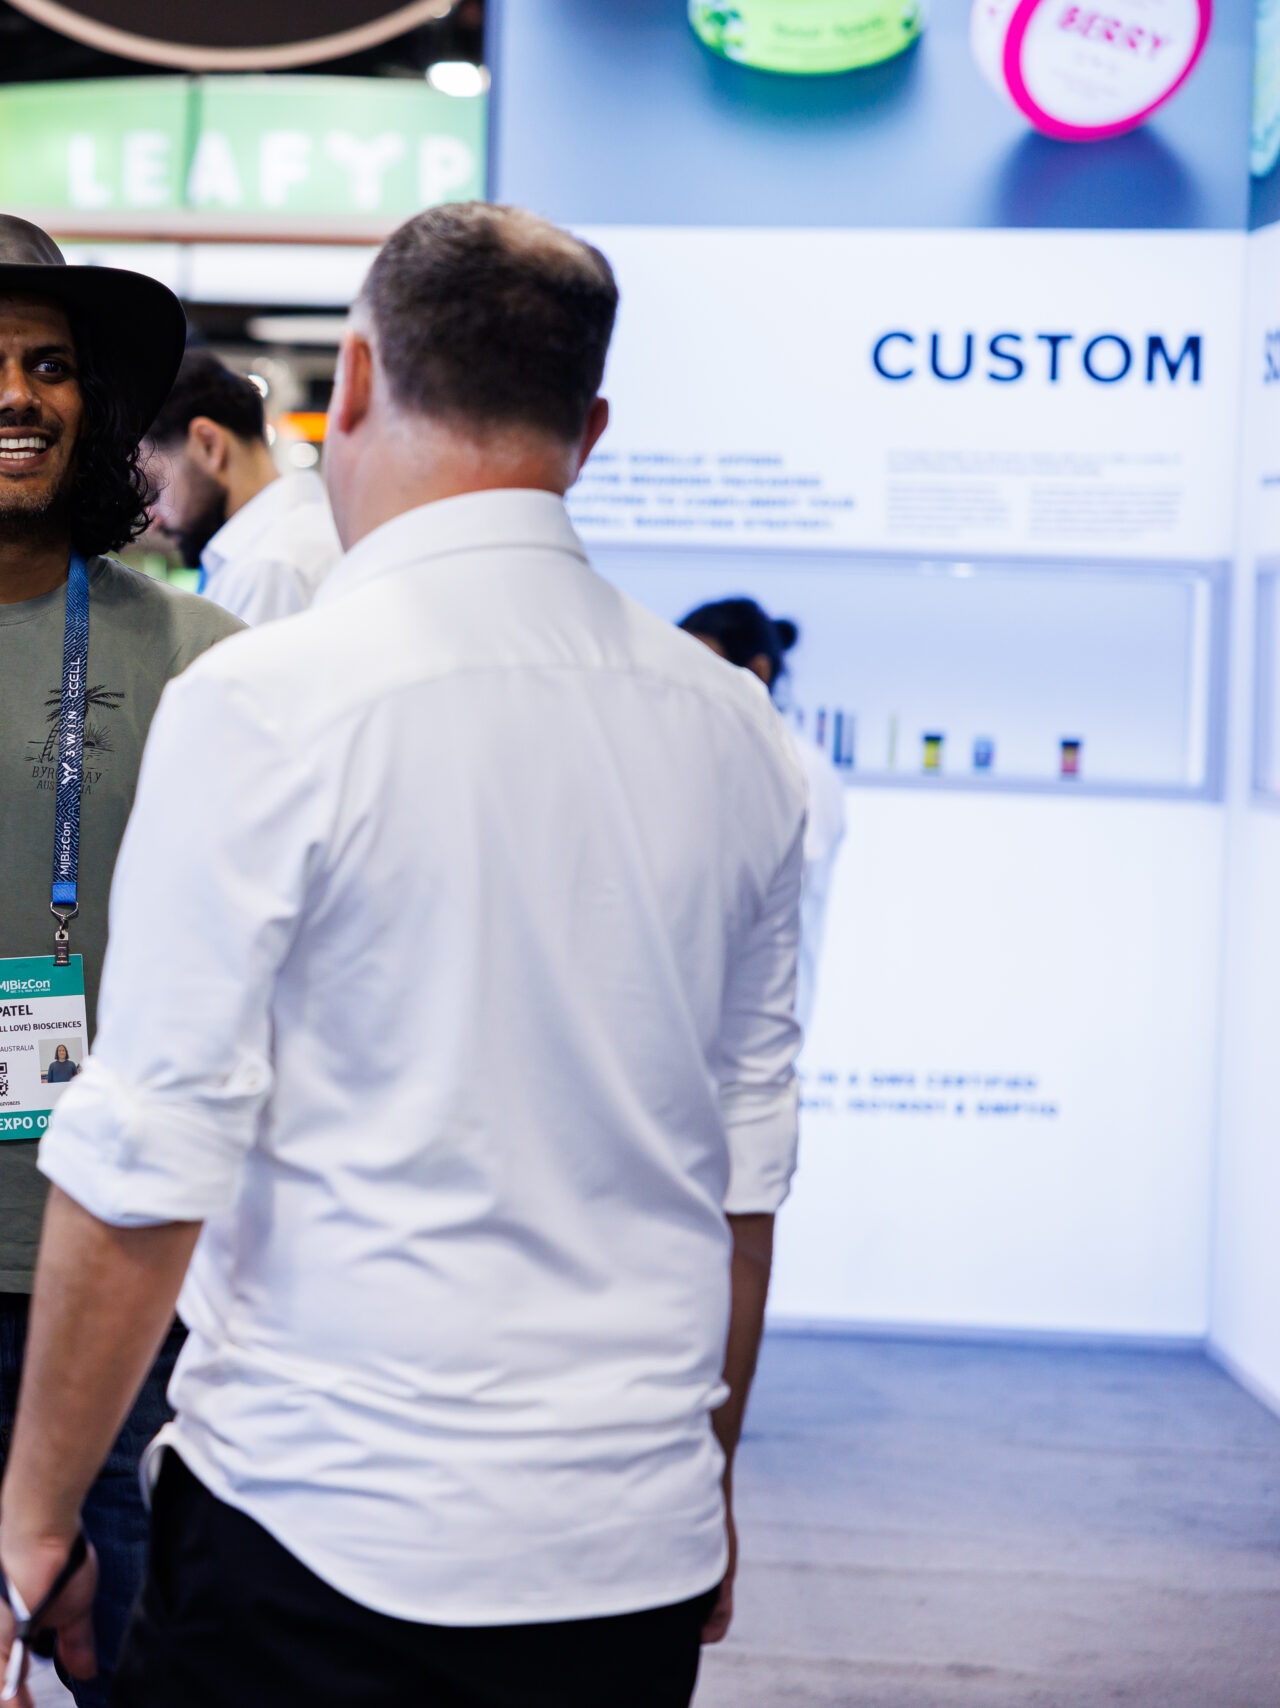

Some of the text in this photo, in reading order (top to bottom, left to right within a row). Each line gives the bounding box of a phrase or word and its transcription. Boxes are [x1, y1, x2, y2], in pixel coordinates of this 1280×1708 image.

[872, 331, 1204, 384] CUSTOM
[68, 657, 80, 699] CCELL
[32, 766, 58, 779] BYR
[59, 821, 71, 875] MJBizCon
[9, 1023, 32, 1032] LOVE)
[33, 1021, 82, 1031] BIOSCIENCES
[0, 1044, 34, 1053] AUSTRALIA
